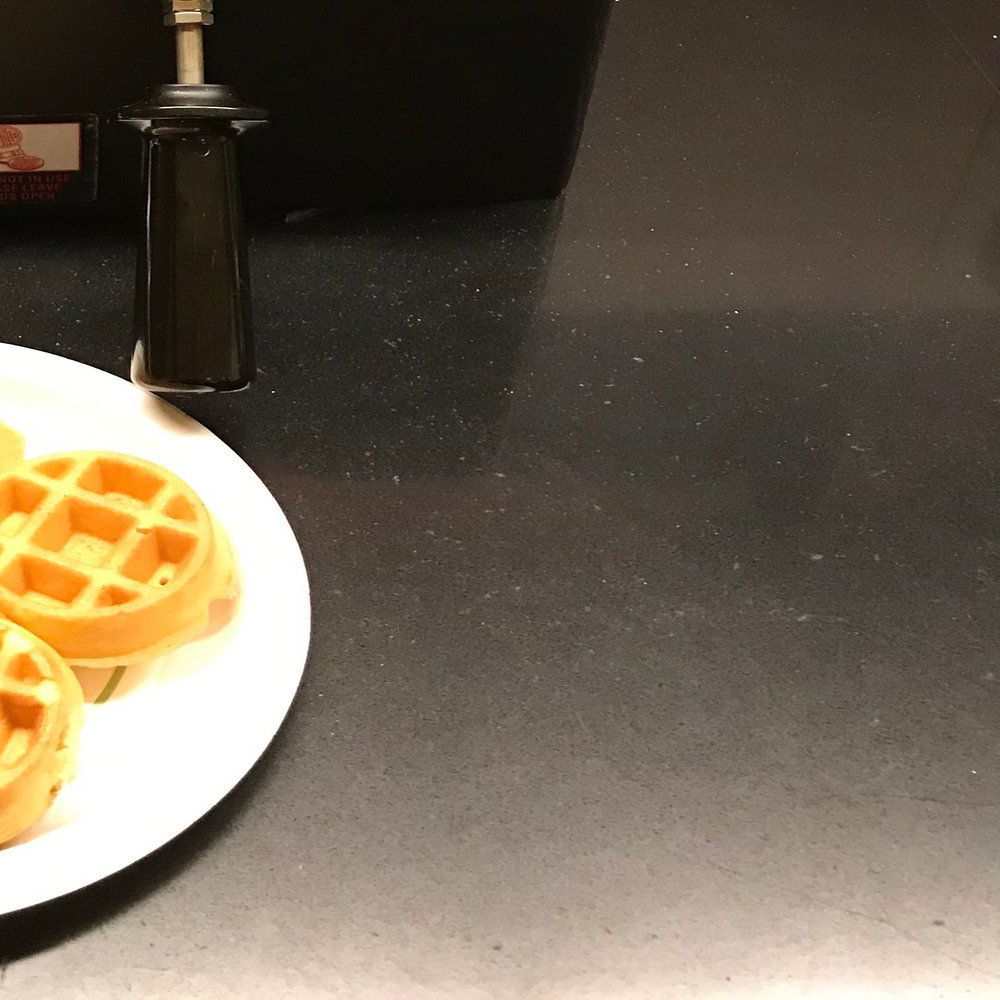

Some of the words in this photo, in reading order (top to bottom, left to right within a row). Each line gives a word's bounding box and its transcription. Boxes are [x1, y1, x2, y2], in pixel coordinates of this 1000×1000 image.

[0, 175, 23, 183] NOT
[29, 174, 42, 183] IN
[46, 174, 72, 182] USE
[22, 183, 64, 192] LEAVE
[21, 192, 56, 200] OPEN
